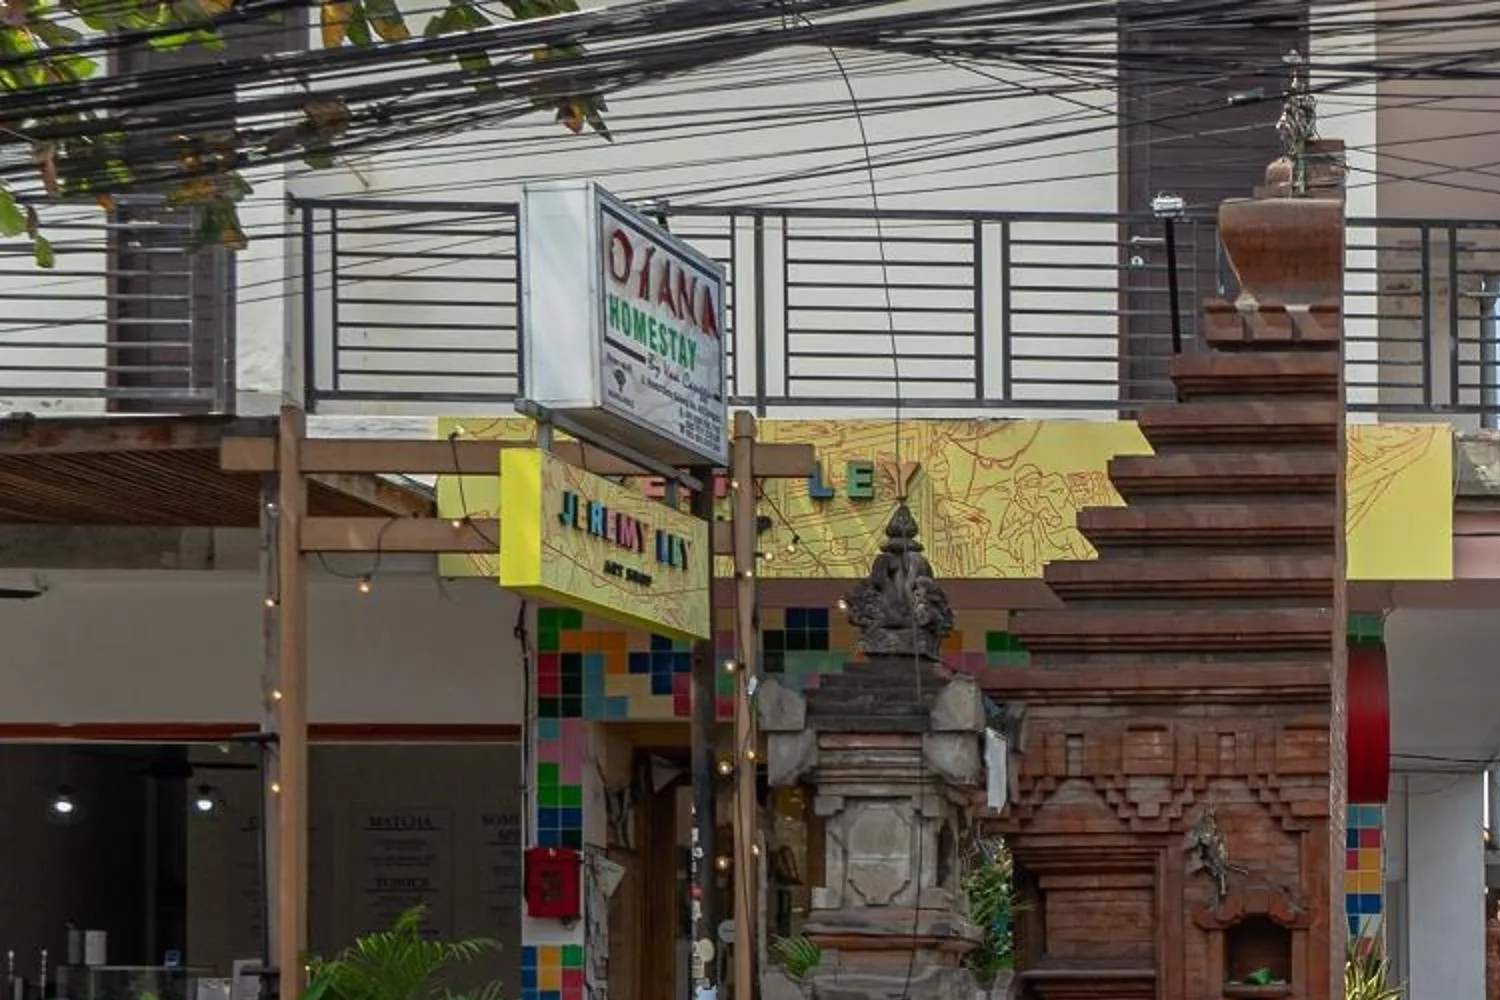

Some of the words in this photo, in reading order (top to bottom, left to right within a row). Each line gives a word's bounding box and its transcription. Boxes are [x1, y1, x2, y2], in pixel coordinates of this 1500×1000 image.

[609, 293, 697, 371] HOMESTAY
[558, 490, 650, 555] JEREMY
[369, 814, 432, 827] MATCHA
